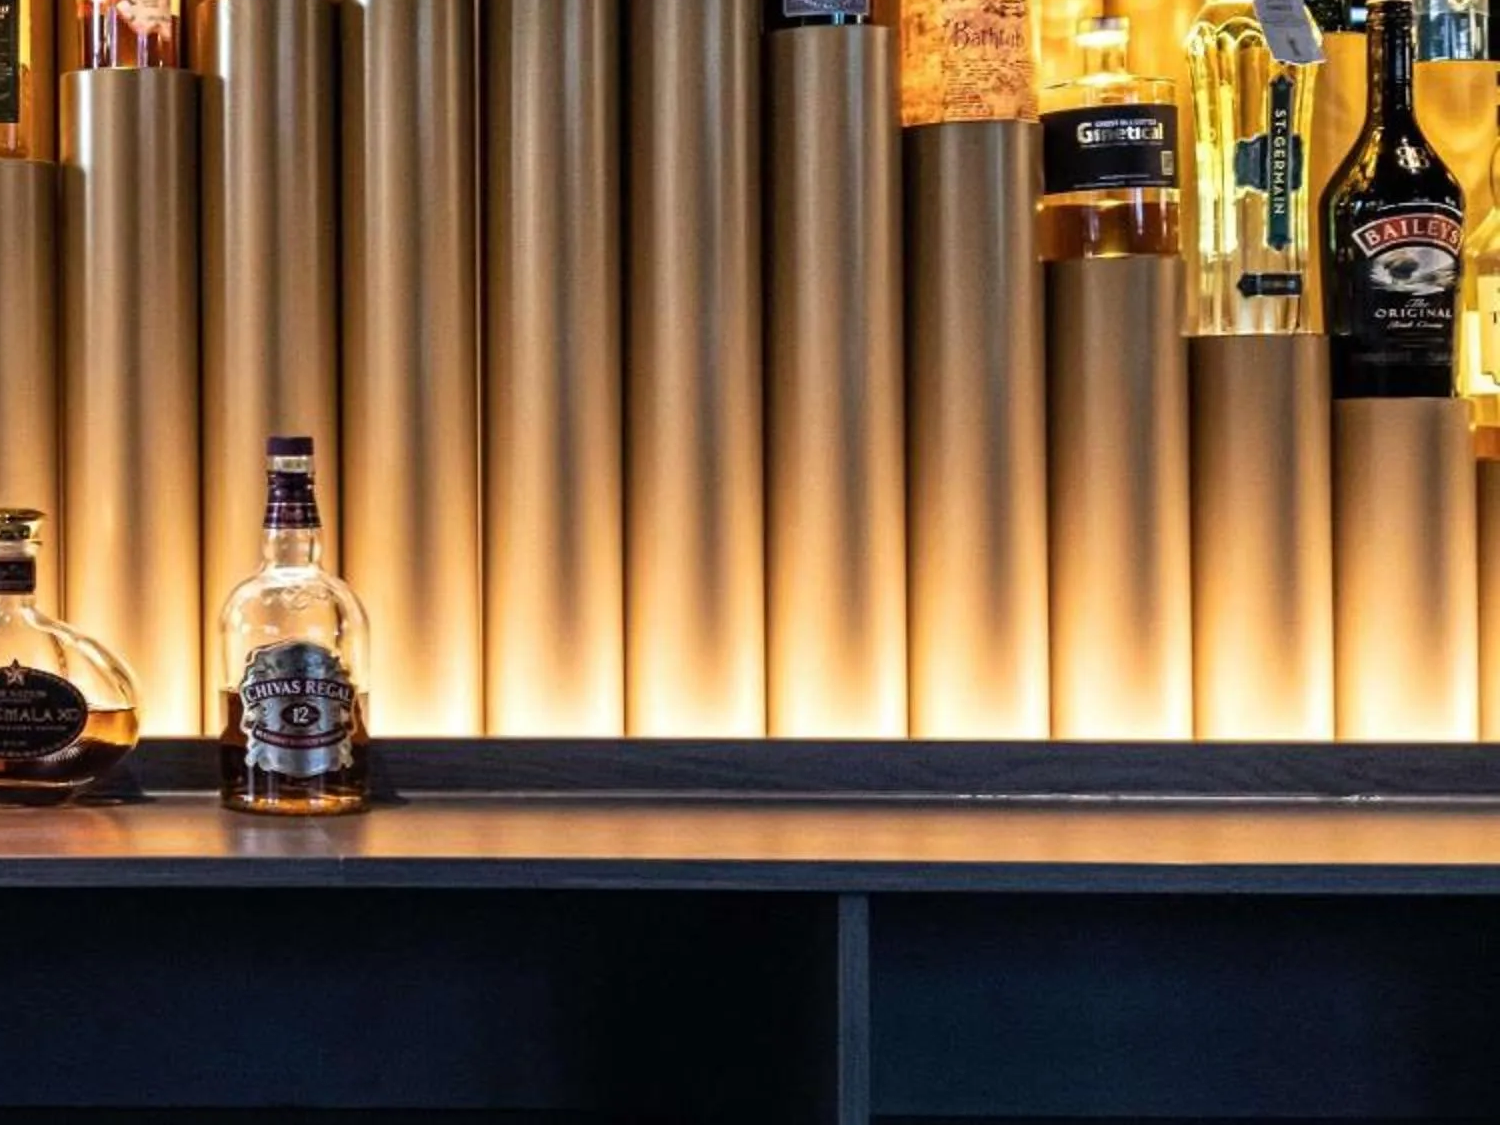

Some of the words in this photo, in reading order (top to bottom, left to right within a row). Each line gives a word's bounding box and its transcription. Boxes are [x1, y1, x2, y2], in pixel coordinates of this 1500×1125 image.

[1077, 121, 1164, 144] Ginetical
[1363, 218, 1459, 246] BAILEYS
[1374, 307, 1453, 319] ORIGINAL
[246, 680, 301, 701] CHIVAS
[305, 680, 351, 702] REGAL
[292, 706, 310, 724] 12
